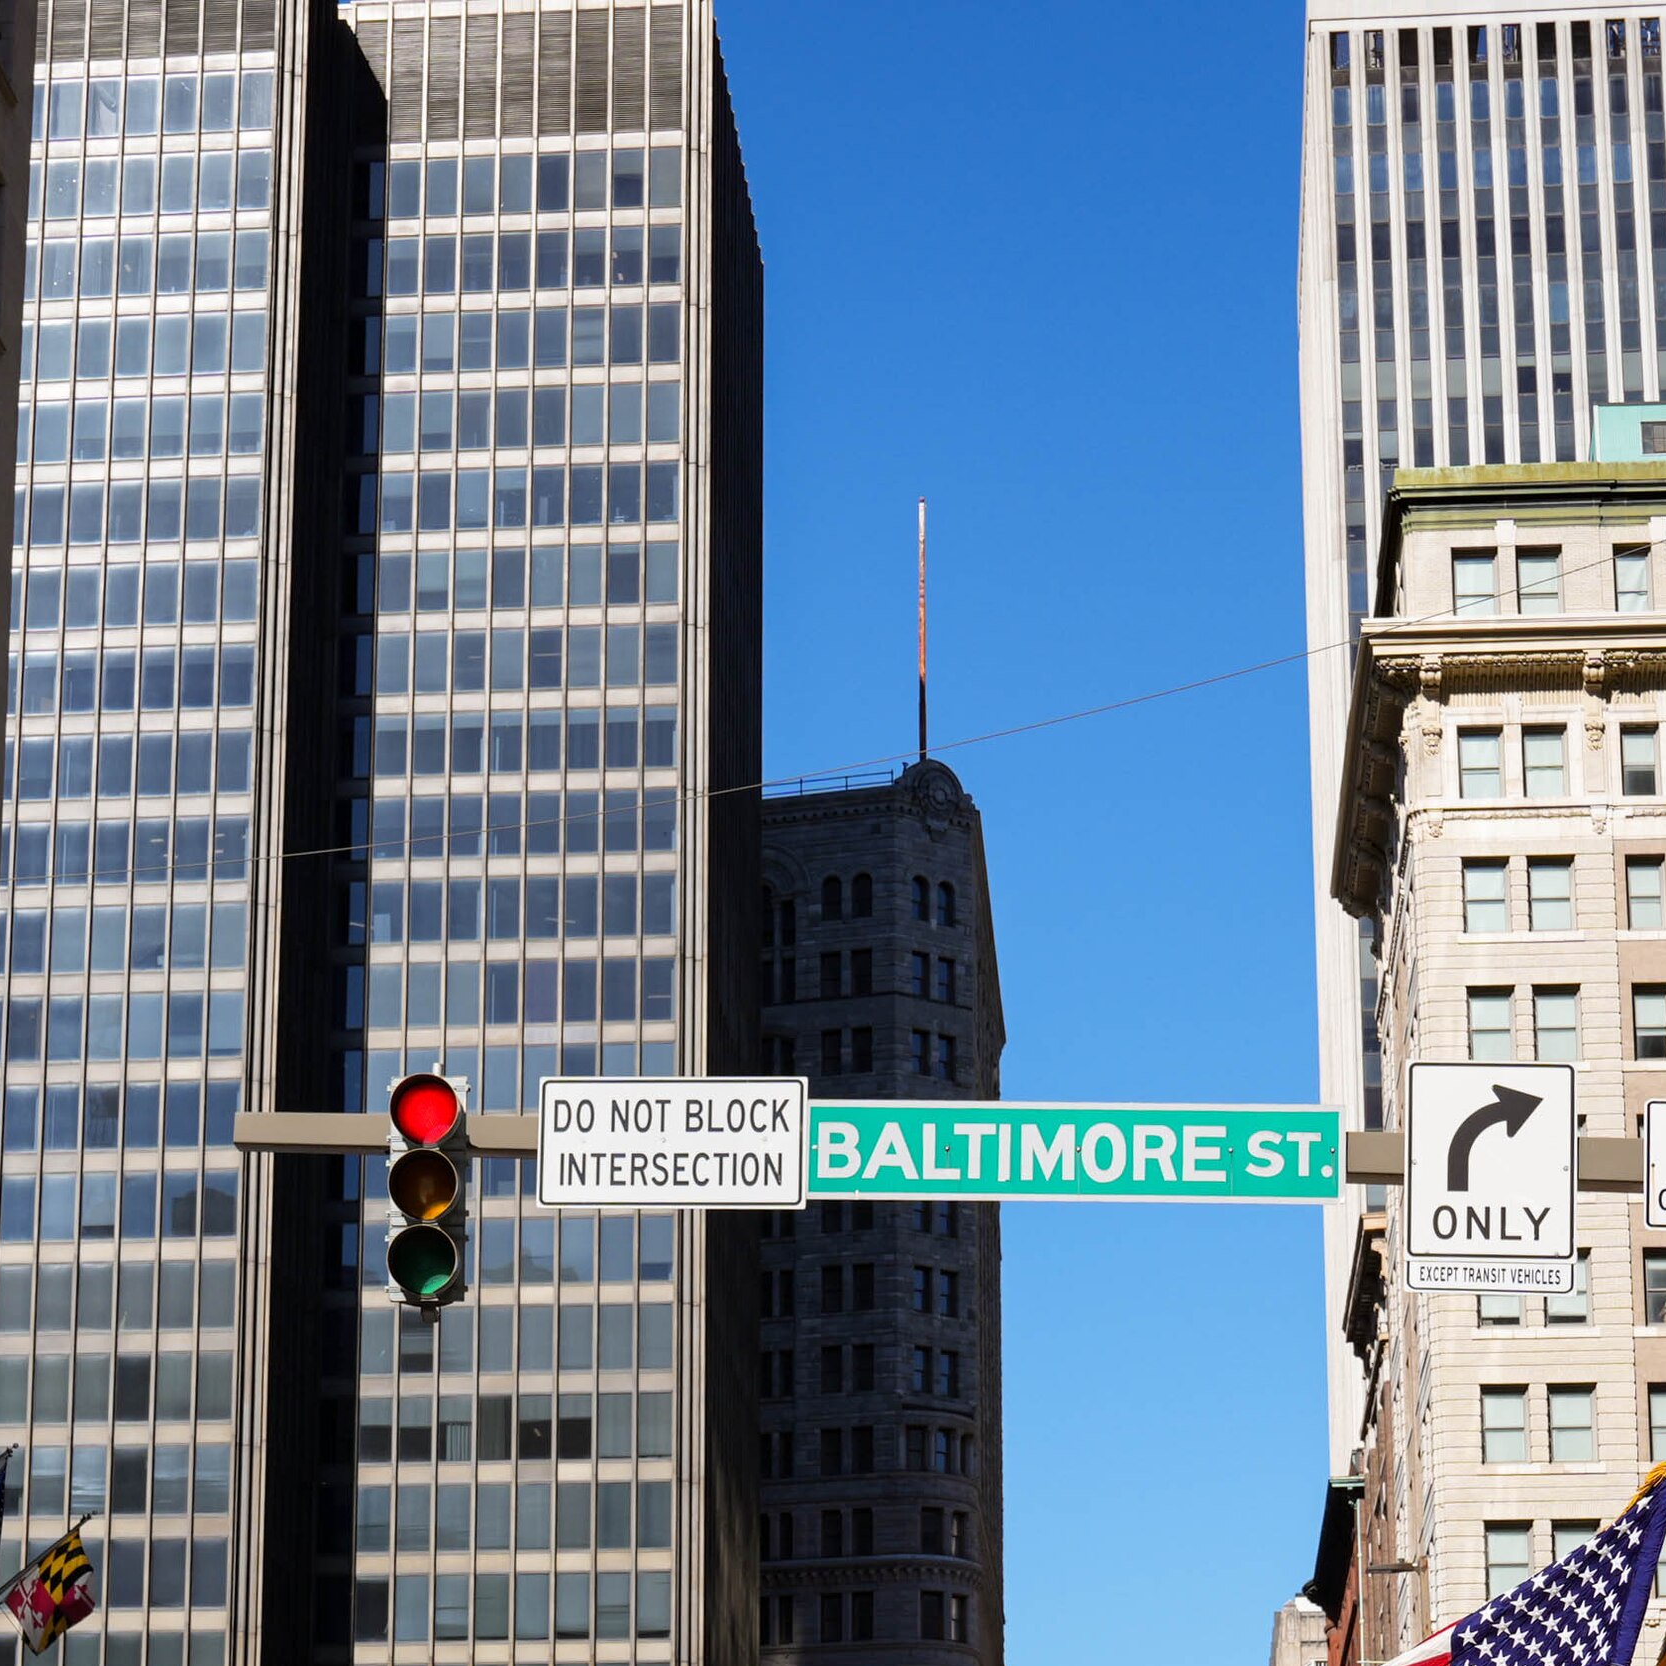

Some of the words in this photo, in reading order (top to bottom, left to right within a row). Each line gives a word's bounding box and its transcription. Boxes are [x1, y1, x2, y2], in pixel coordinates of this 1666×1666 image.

[552, 1098, 601, 1131] DO
[609, 1097, 671, 1130] NOT
[680, 1097, 790, 1133] BLOCK
[557, 1147, 784, 1187] INTERSECTION
[816, 1121, 1229, 1183] BALTIMORE
[1244, 1129, 1335, 1178] ST.
[1432, 1205, 1551, 1241] ONLY
[1419, 1266, 1459, 1282] EXCEPT
[1463, 1267, 1506, 1284] TRANSIT
[1511, 1268, 1561, 1286] VEHICLES
